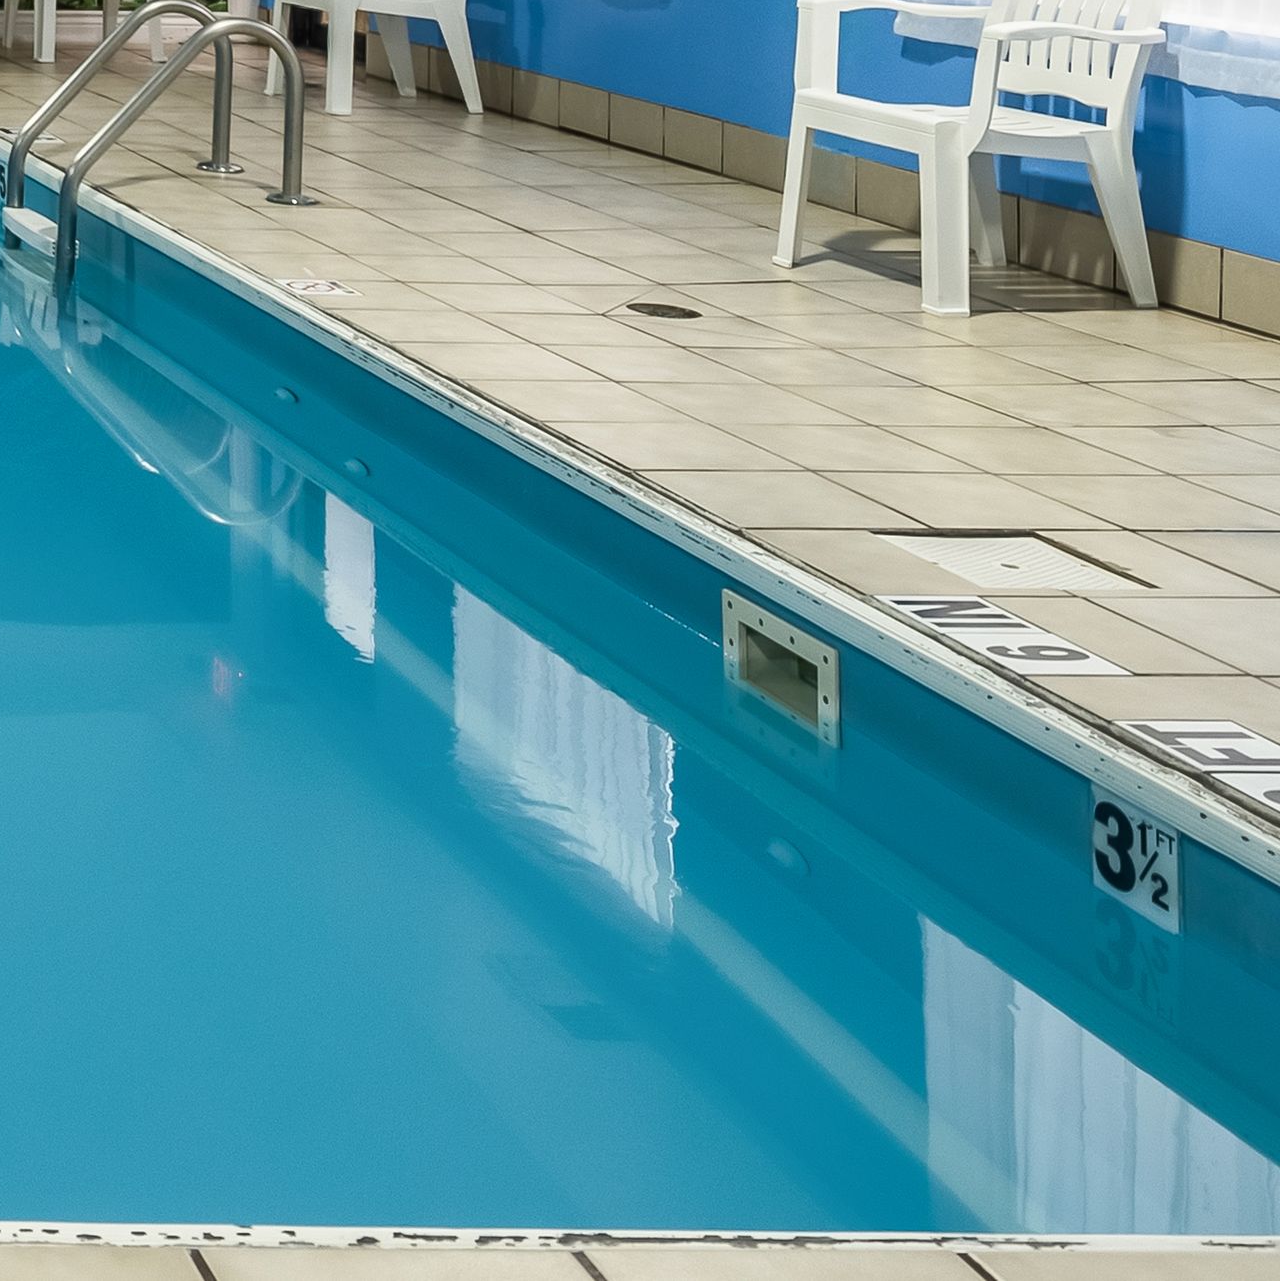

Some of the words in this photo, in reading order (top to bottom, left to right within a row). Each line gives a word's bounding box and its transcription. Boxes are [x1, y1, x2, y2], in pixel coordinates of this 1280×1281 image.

[890, 599, 1032, 629] IN
[985, 644, 1090, 661] 6
[1094, 801, 1136, 894] 3
[1156, 828, 1176, 856] FT
